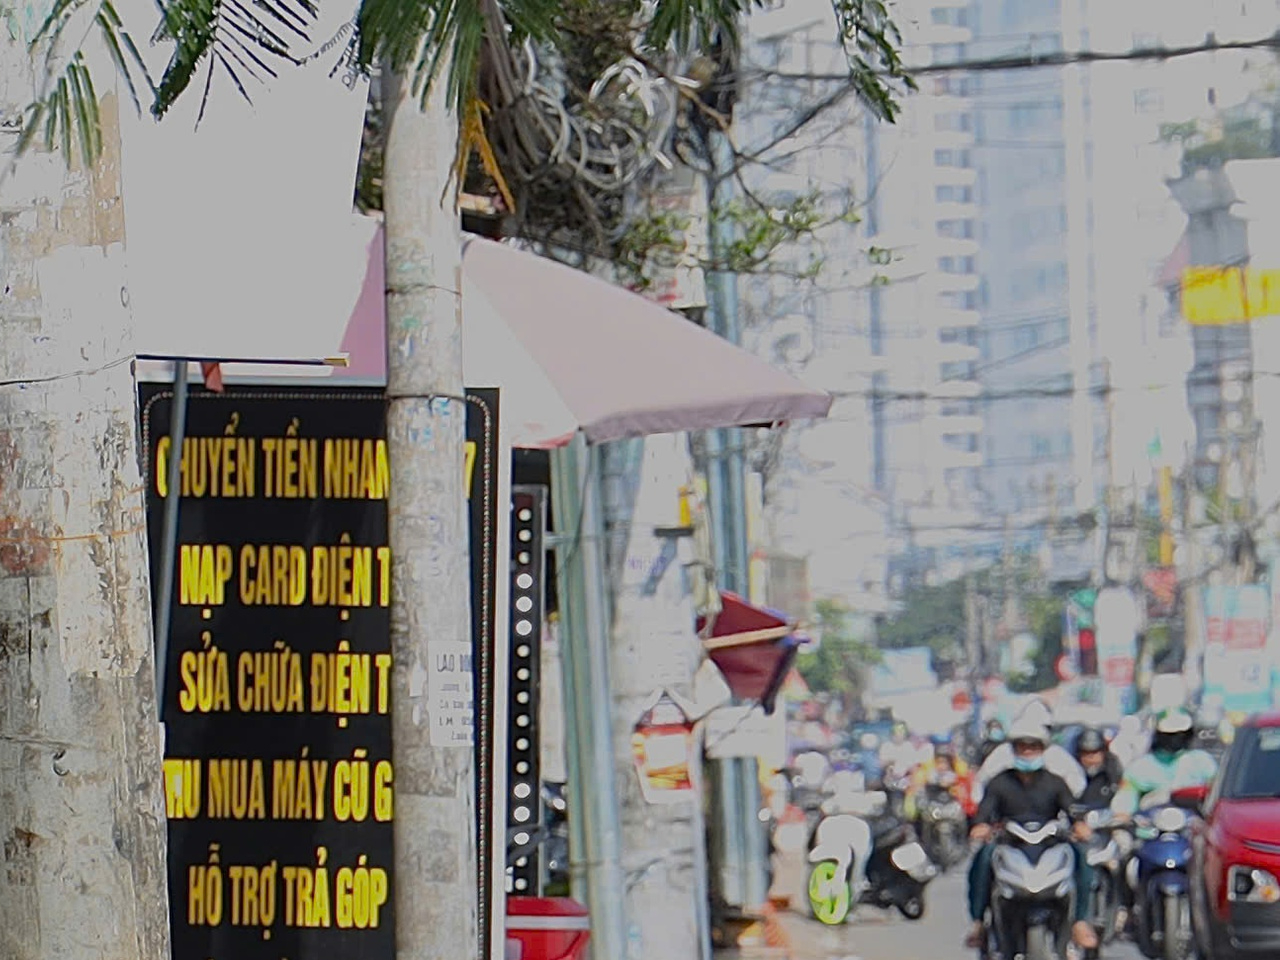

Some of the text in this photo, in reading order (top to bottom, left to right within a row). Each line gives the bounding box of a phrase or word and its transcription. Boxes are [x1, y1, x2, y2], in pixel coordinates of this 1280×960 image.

[180, 545, 233, 619] NẠP
[240, 544, 306, 606] CARD
[312, 532, 371, 621] ĐIỆN
[180, 631, 231, 713] SỬA
[238, 640, 304, 713] CHỮA
[310, 640, 370, 728] ĐIỆN
[208, 759, 265, 819] MUA
[273, 746, 328, 821] MÁY
[334, 748, 369, 822] CŨ
[189, 842, 388, 940] HỖ TRỢ TRẢ GÓP
